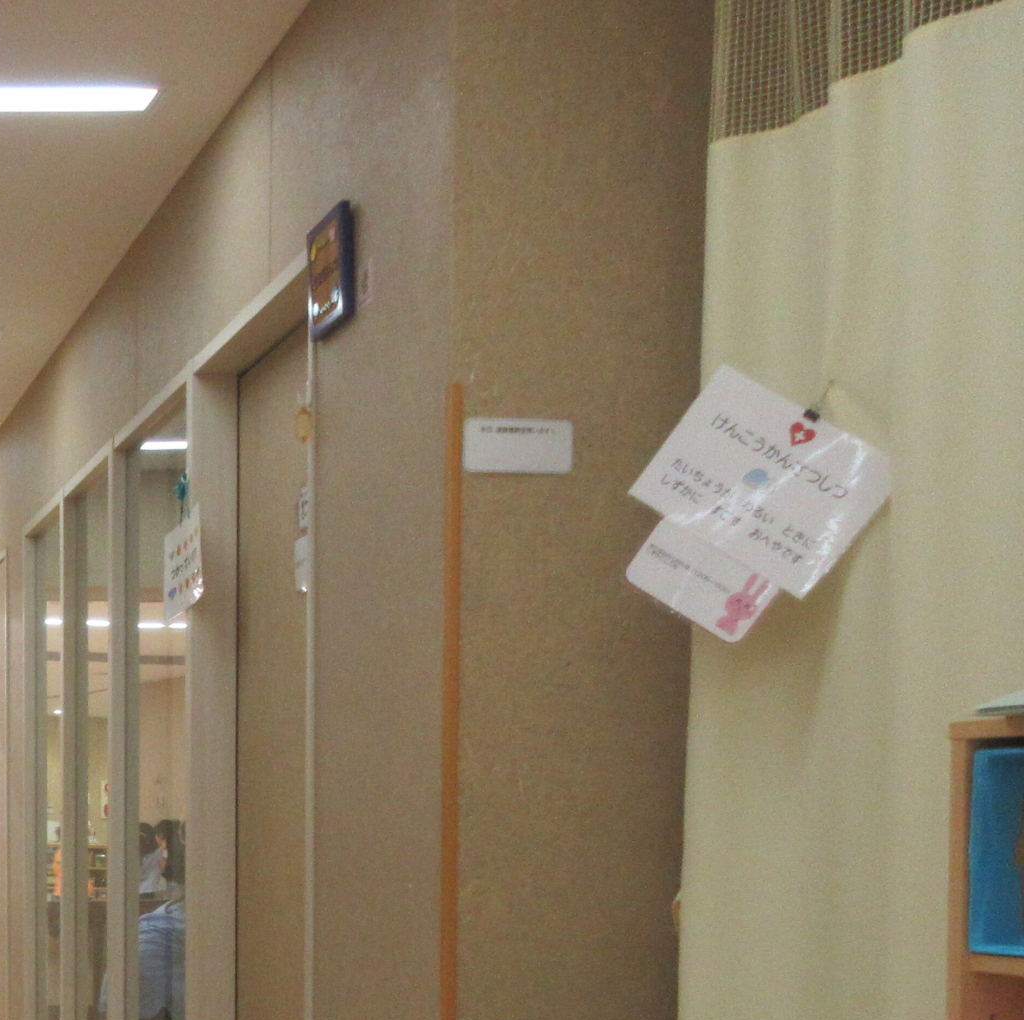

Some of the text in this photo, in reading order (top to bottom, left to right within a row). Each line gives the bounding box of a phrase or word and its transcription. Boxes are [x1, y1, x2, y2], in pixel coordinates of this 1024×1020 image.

[711, 413, 849, 499] けんこうかんさつしつ
